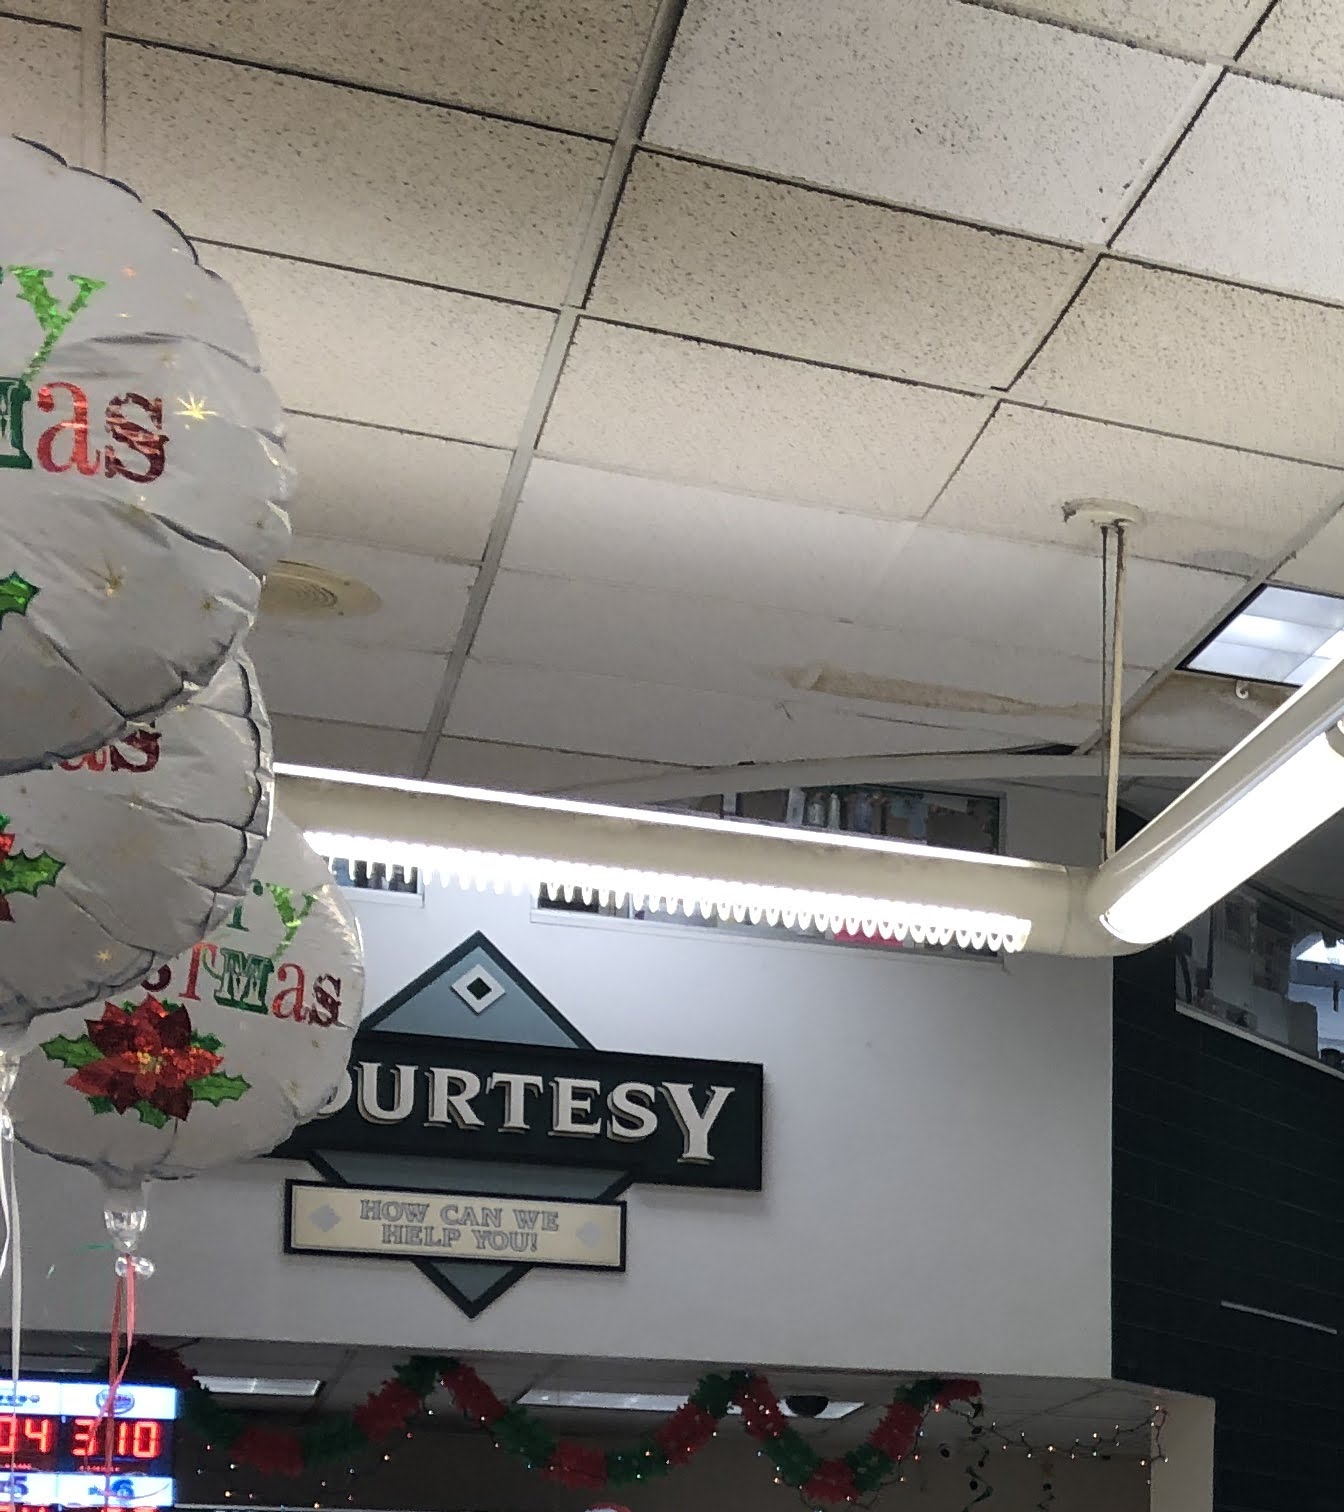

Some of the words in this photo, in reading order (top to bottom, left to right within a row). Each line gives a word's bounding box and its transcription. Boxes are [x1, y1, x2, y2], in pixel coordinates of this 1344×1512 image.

[318, 1060, 736, 1164] URTESY
[360, 1199, 429, 1224] HOW
[440, 1204, 502, 1228] CAN
[512, 1208, 559, 1232] WE
[382, 1223, 460, 1250] HELP
[472, 1228, 539, 1253] YOU!
